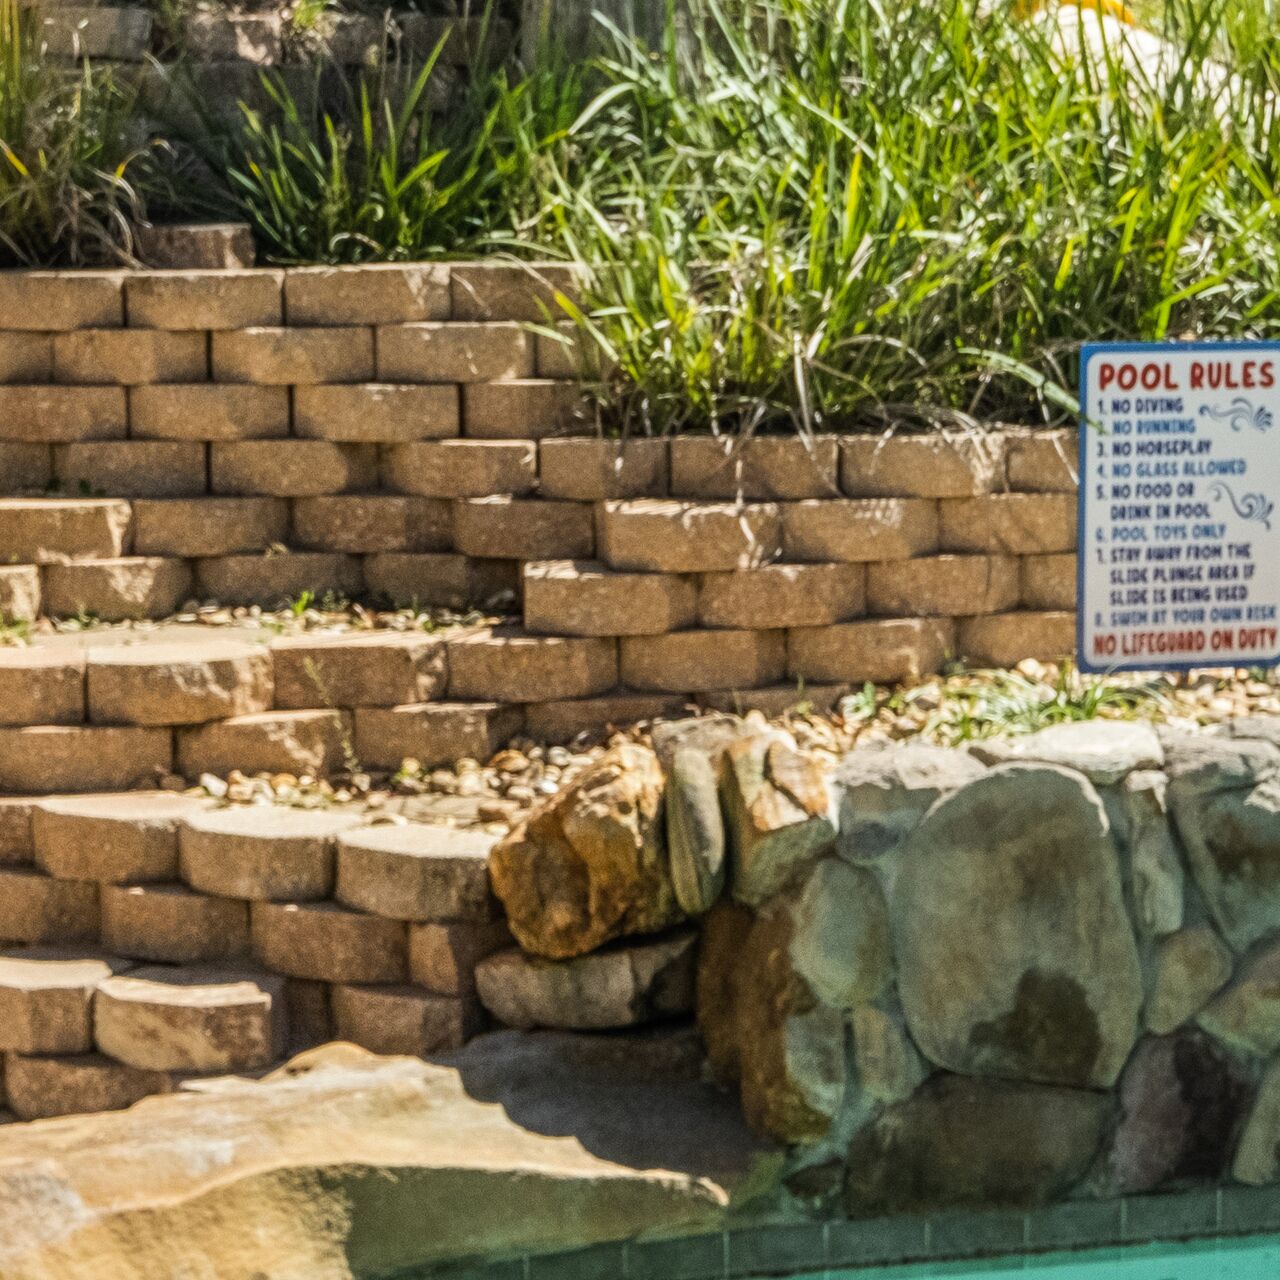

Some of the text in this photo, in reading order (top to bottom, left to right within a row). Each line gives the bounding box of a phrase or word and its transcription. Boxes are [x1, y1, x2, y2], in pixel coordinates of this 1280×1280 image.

[1099, 362, 1274, 391] POOL RULES
[1097, 398, 1184, 414] 1. NO DIVING
[1113, 421, 1132, 434] NO
[1137, 420, 1196, 434] RUNNING
[1097, 440, 1212, 457] 3. NO HORSEPLAY
[1097, 459, 1247, 478] 4. NO GLASS ALLOWED
[1096, 483, 1194, 500] 5. NO FOOD OR
[1111, 504, 1211, 520] DRINK IN POOL
[1096, 524, 1226, 542] 6. POOL TOYS ONLY
[1111, 548, 1141, 563] STAY
[1146, 546, 1181, 562] AWAY
[1186, 545, 1222, 560] FROM
[1227, 544, 1251, 559] THE
[1111, 564, 1255, 584] SLIDE PLUNGE AREA IF
[1111, 586, 1248, 605] SLIDE IS BEING USED
[1111, 610, 1148, 625] SWIM
[1152, 609, 1167, 624] AT
[1173, 608, 1205, 623] YOUR
[1210, 607, 1242, 622] OWN
[1247, 605, 1276, 621] RISK
[1093, 628, 1277, 656] NO LIFEGUARD ON DUTY
